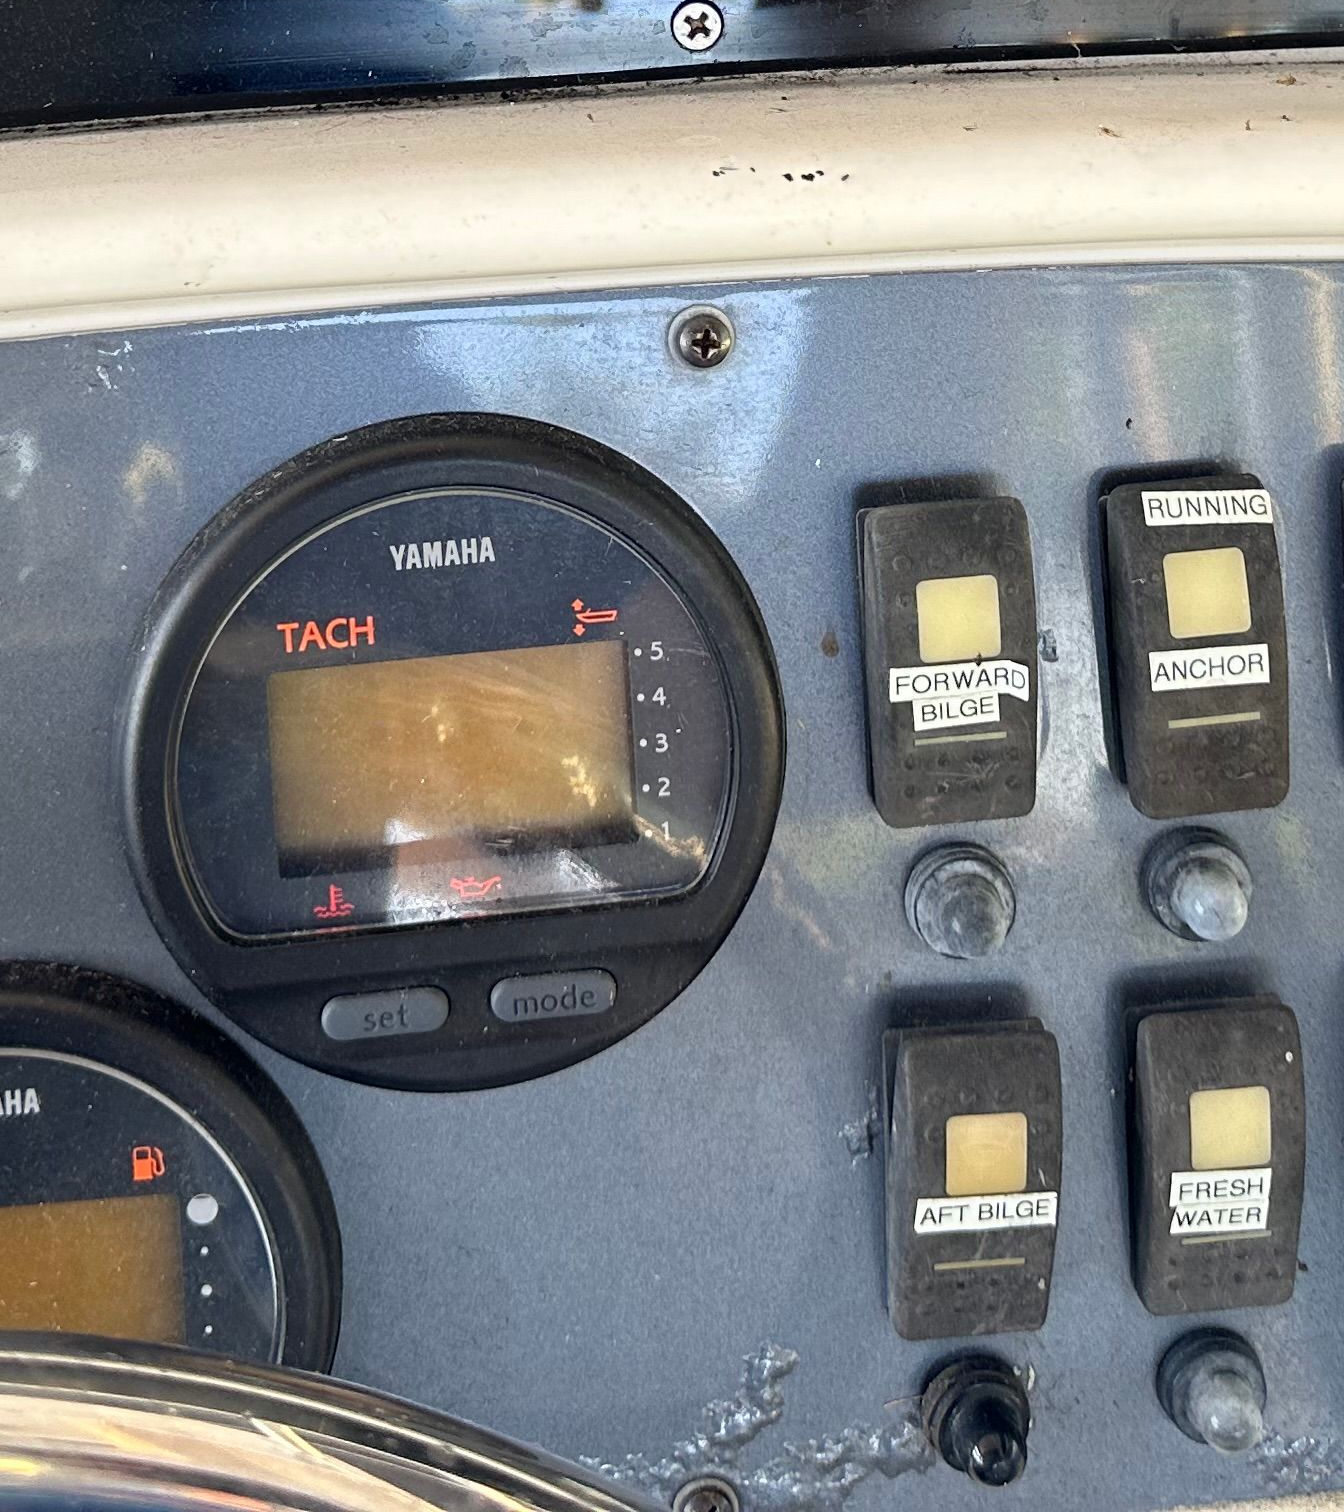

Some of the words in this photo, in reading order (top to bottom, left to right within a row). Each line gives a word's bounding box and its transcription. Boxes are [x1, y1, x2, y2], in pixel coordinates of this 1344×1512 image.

[1148, 495, 1268, 520] RUNNING
[389, 536, 496, 571] YAMAHA
[276, 616, 375, 653] TACH
[649, 641, 664, 662] 5
[896, 666, 1026, 695] FORWARD
[1154, 653, 1265, 684] ANCHOR
[652, 687, 667, 707] 4
[921, 696, 995, 723] BILGE
[654, 734, 669, 753] 3
[657, 778, 671, 796] 2
[661, 821, 670, 839] 1
[513, 985, 596, 1017] mode
[362, 1003, 409, 1032] set
[1178, 1177, 1264, 1199] FRESH
[919, 1203, 968, 1226] AFT
[977, 1198, 1050, 1223] BILGE
[1175, 1205, 1262, 1227] WATER
